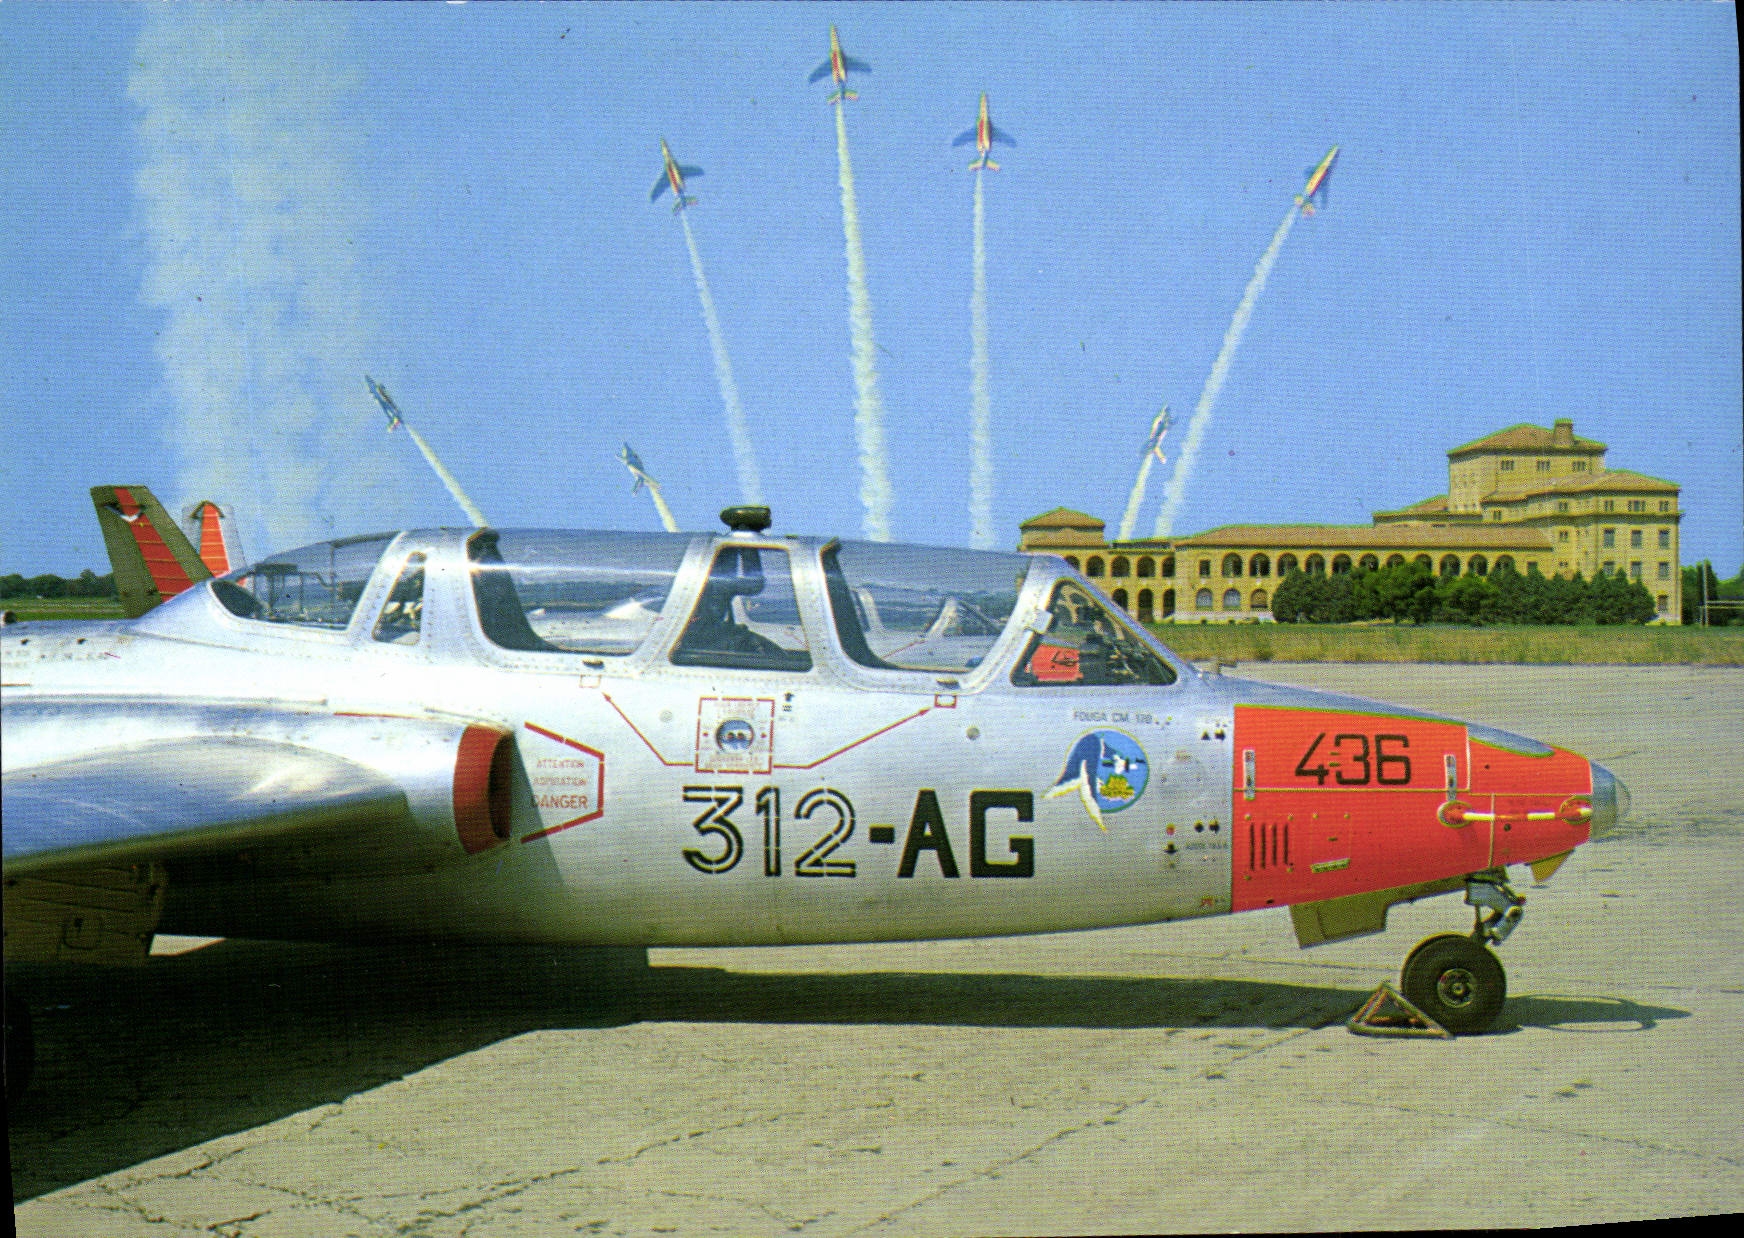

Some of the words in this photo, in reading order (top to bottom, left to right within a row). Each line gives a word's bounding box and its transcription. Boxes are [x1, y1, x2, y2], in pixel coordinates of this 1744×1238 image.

[536, 758, 585, 769] ATTENTION
[1294, 732, 1412, 787] 436
[530, 794, 589, 810] DANGER
[682, 786, 1035, 878] 312-AG
